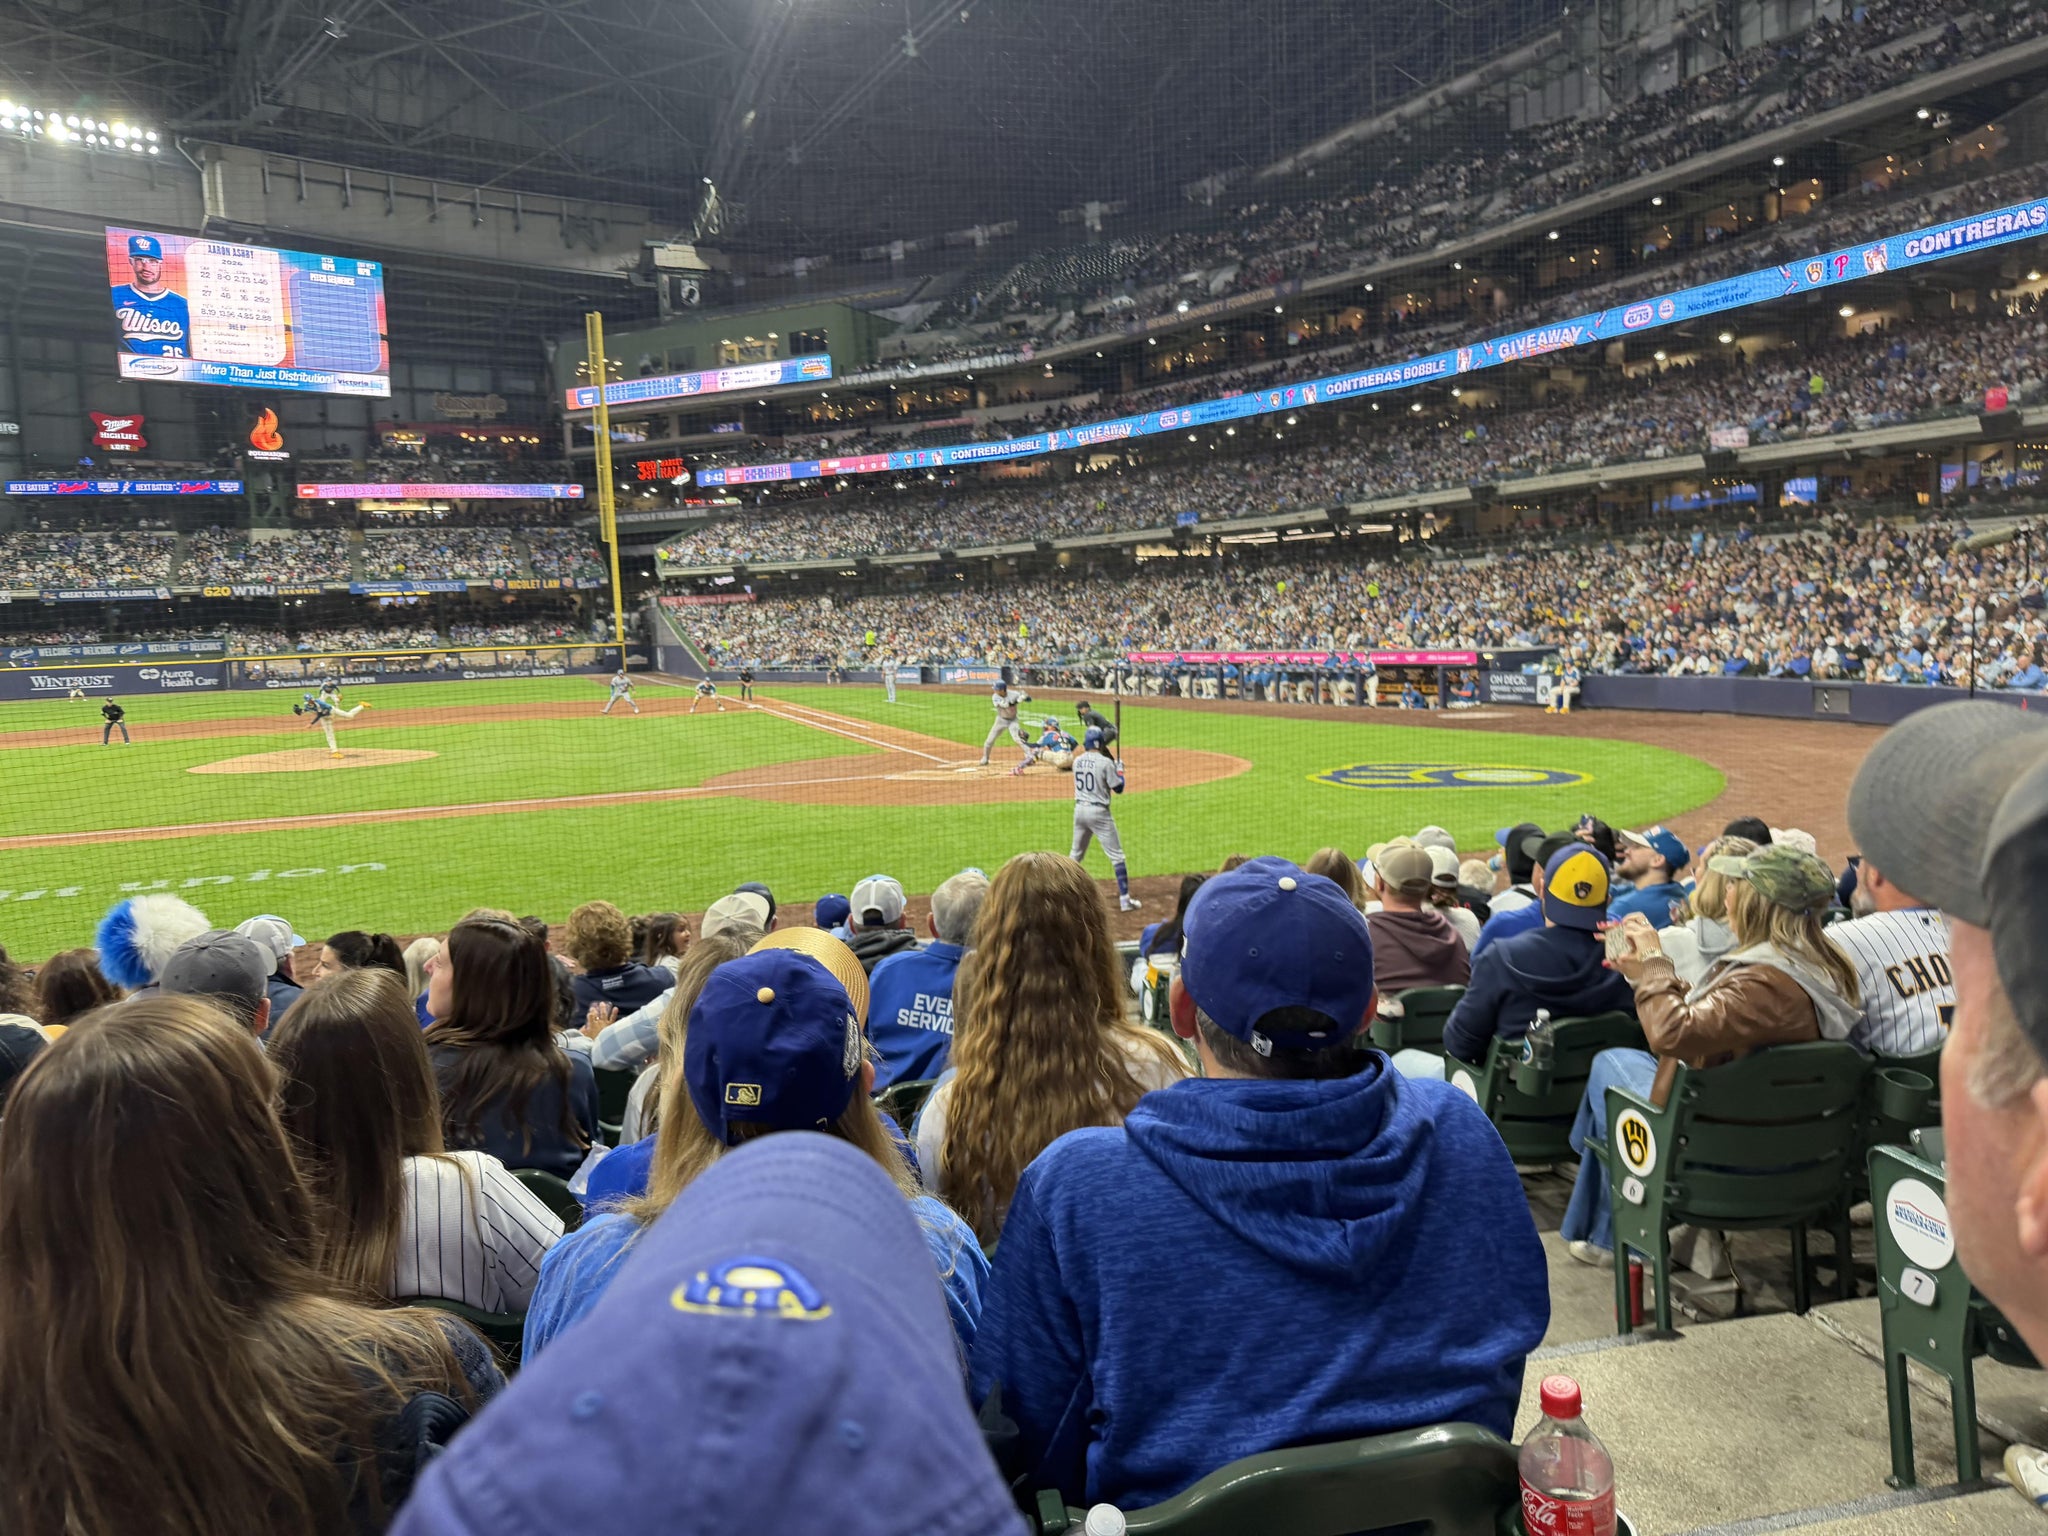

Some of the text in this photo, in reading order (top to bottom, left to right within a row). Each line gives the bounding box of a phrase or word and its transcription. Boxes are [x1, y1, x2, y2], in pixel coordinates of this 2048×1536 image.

[1904, 205, 2047, 258] CONTRERAS
[1687, 297, 1719, 312] Nicolet
[115, 308, 183, 336] Wisco
[1499, 326, 1584, 359] GIVEAWAY
[201, 364, 226, 376] More
[229, 366, 253, 378] Than
[255, 368, 276, 380] Just
[1326, 359, 1446, 396] CONTRERAS BOBBLE
[1076, 423, 1133, 443] GIVEAWAY
[950, 440, 1041, 460] CONTRERAS BOBBLE
[59, 591, 83, 599] GREAT
[203, 585, 275, 597] 620 WTMJ
[30, 675, 115, 688] WINTRUST
[161, 670, 194, 679] Aurora
[161, 677, 219, 687] Health Care
[1490, 674, 1503, 685] ON
[1075, 772, 1094, 791] 50
[1885, 952, 1952, 999] CHO
[913, 993, 954, 1016] EVEN
[897, 1008, 954, 1035] SERVIC
[1914, 1275, 1923, 1295] 7
[1522, 1488, 1560, 1526] Cola
